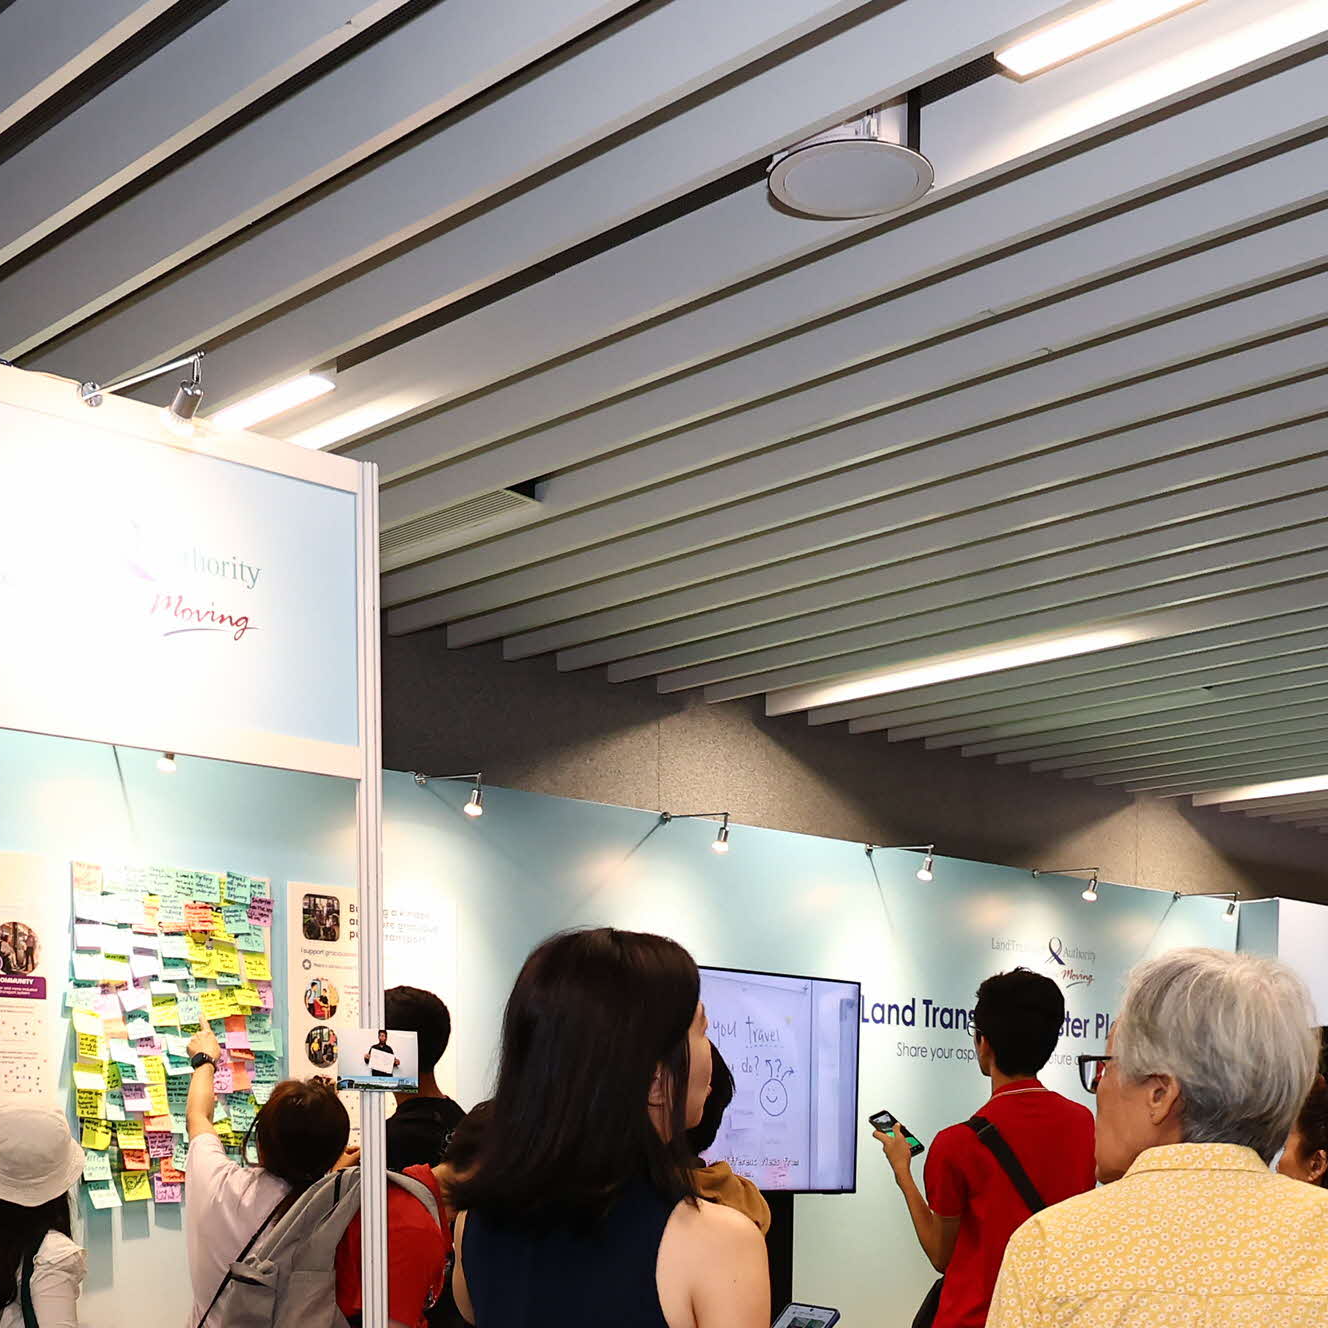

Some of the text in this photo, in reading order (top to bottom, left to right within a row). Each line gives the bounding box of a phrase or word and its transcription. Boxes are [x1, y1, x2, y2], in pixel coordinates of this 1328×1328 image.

[150, 592, 262, 641] Moving
[303, 948, 324, 956] support
[1064, 948, 1096, 962] Authority
[1062, 968, 1095, 984] Moving
[861, 995, 916, 1028] Land
[712, 1016, 780, 1048] you travel
[896, 1042, 928, 1058] Share
[930, 1044, 954, 1061] your
[741, 1055, 760, 1077] do?
